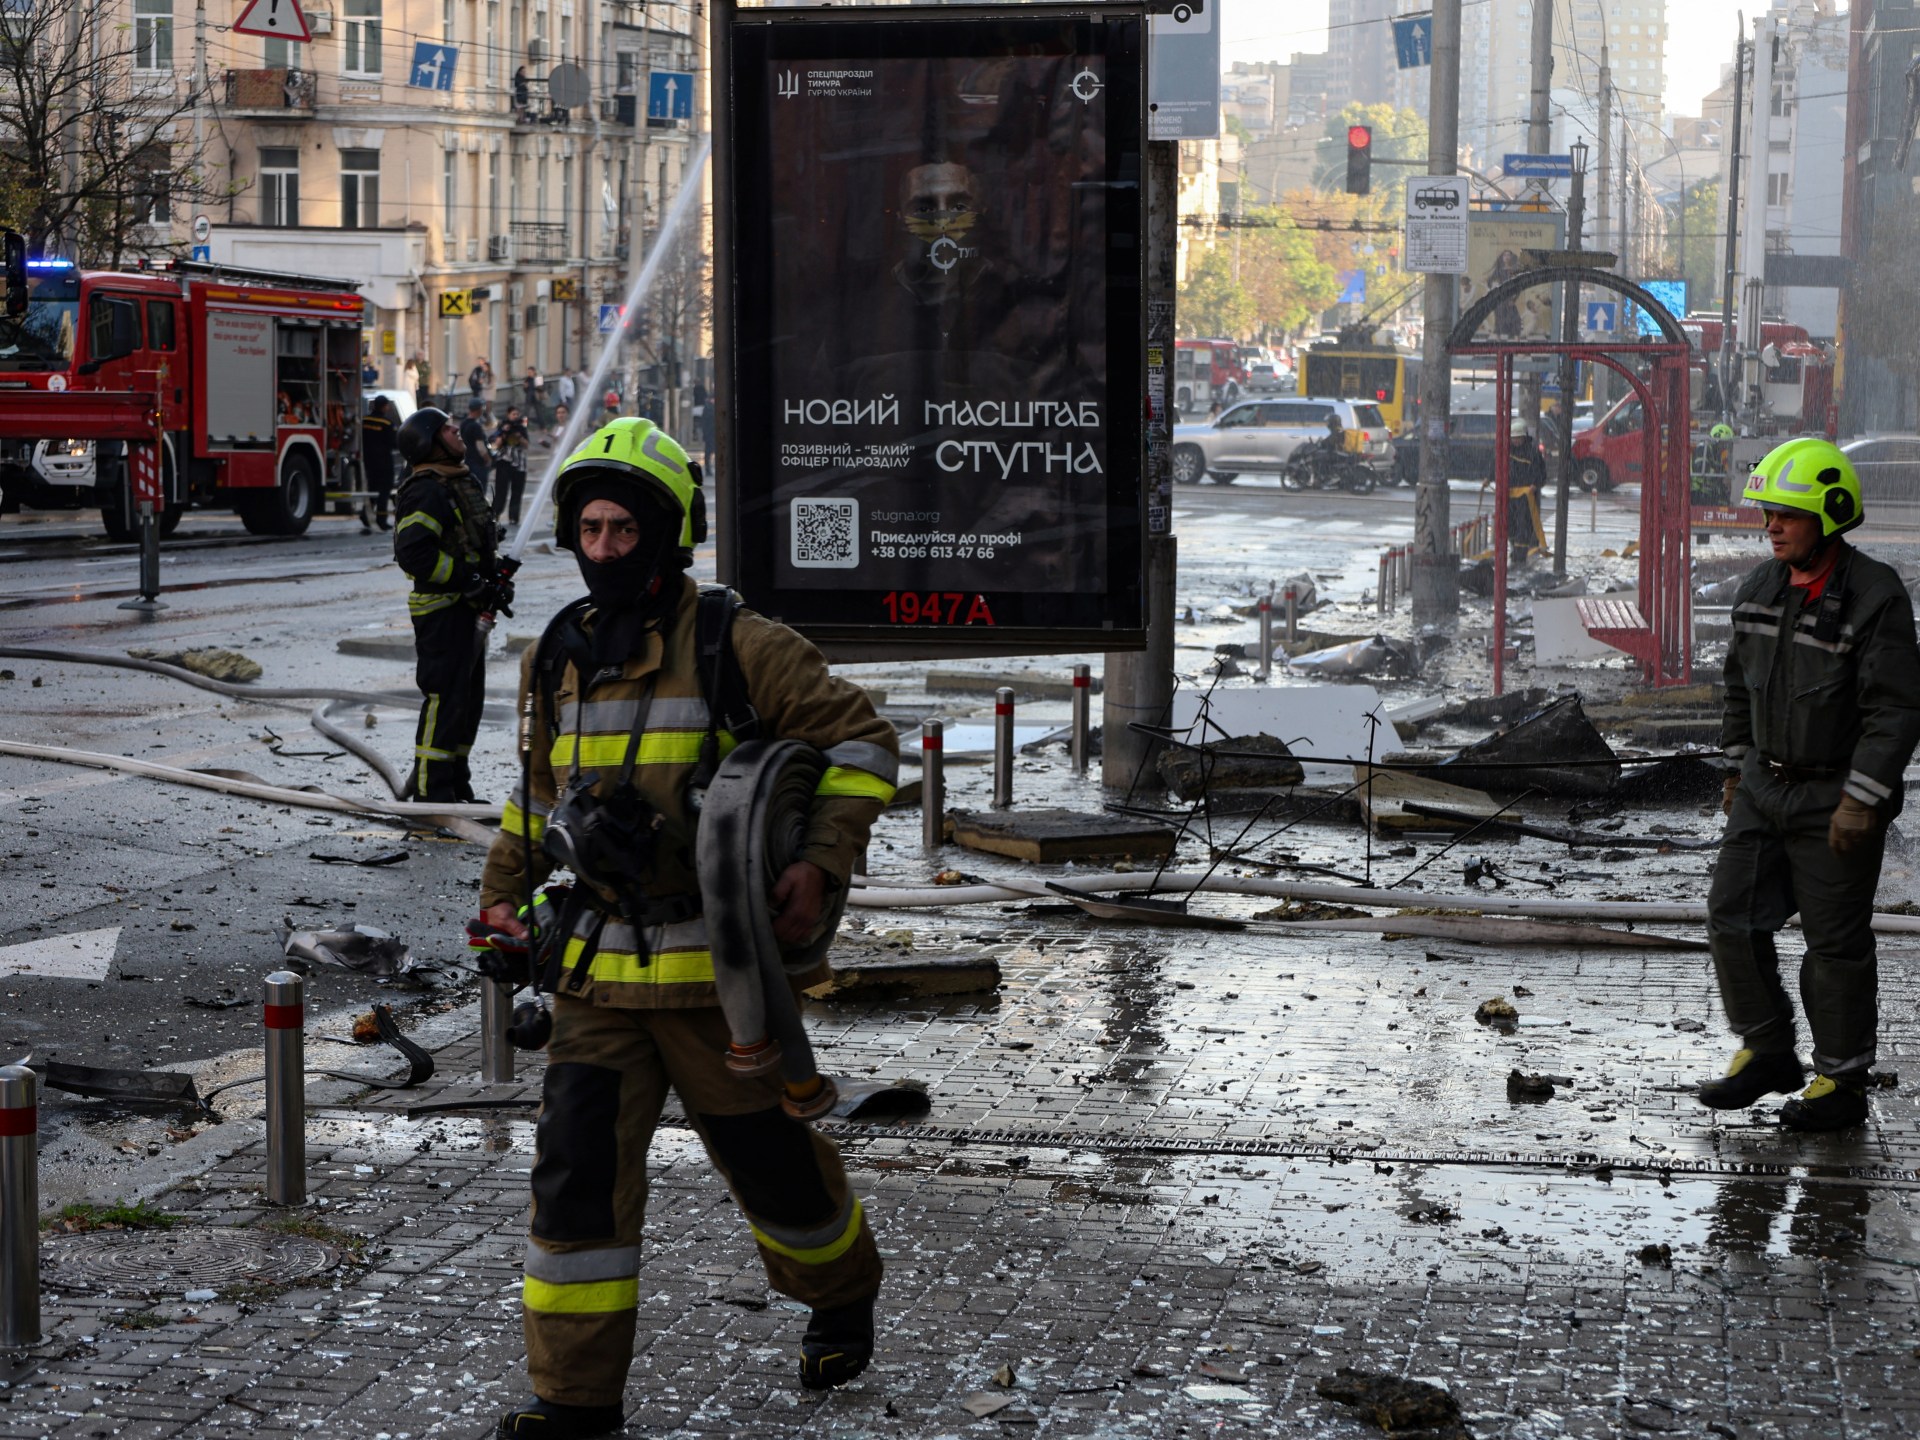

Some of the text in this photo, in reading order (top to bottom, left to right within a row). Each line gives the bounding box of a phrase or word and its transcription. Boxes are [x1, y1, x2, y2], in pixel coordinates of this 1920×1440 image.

[807, 70, 874, 79] СПЕЦПІДРОЗДІЛ
[807, 80, 841, 88] ТИМУРА
[807, 87, 872, 97] ГУР МО УКРАЇНИ
[784, 393, 1100, 427] НОВИЙ МАСШТАБ
[603, 433, 616, 454] 1
[781, 443, 851, 455] ПОЗИВНИЙ
[781, 456, 910, 469] ОФІЦЕР ПІДРОЗДІЛУ
[935, 440, 1104, 480] СТУГНА
[1749, 476, 1764, 490] IV
[871, 509, 941, 524] stugna.org
[871, 530, 1021, 546] Приєднуйся до профі
[871, 546, 994, 559] +38 096 613 47 66
